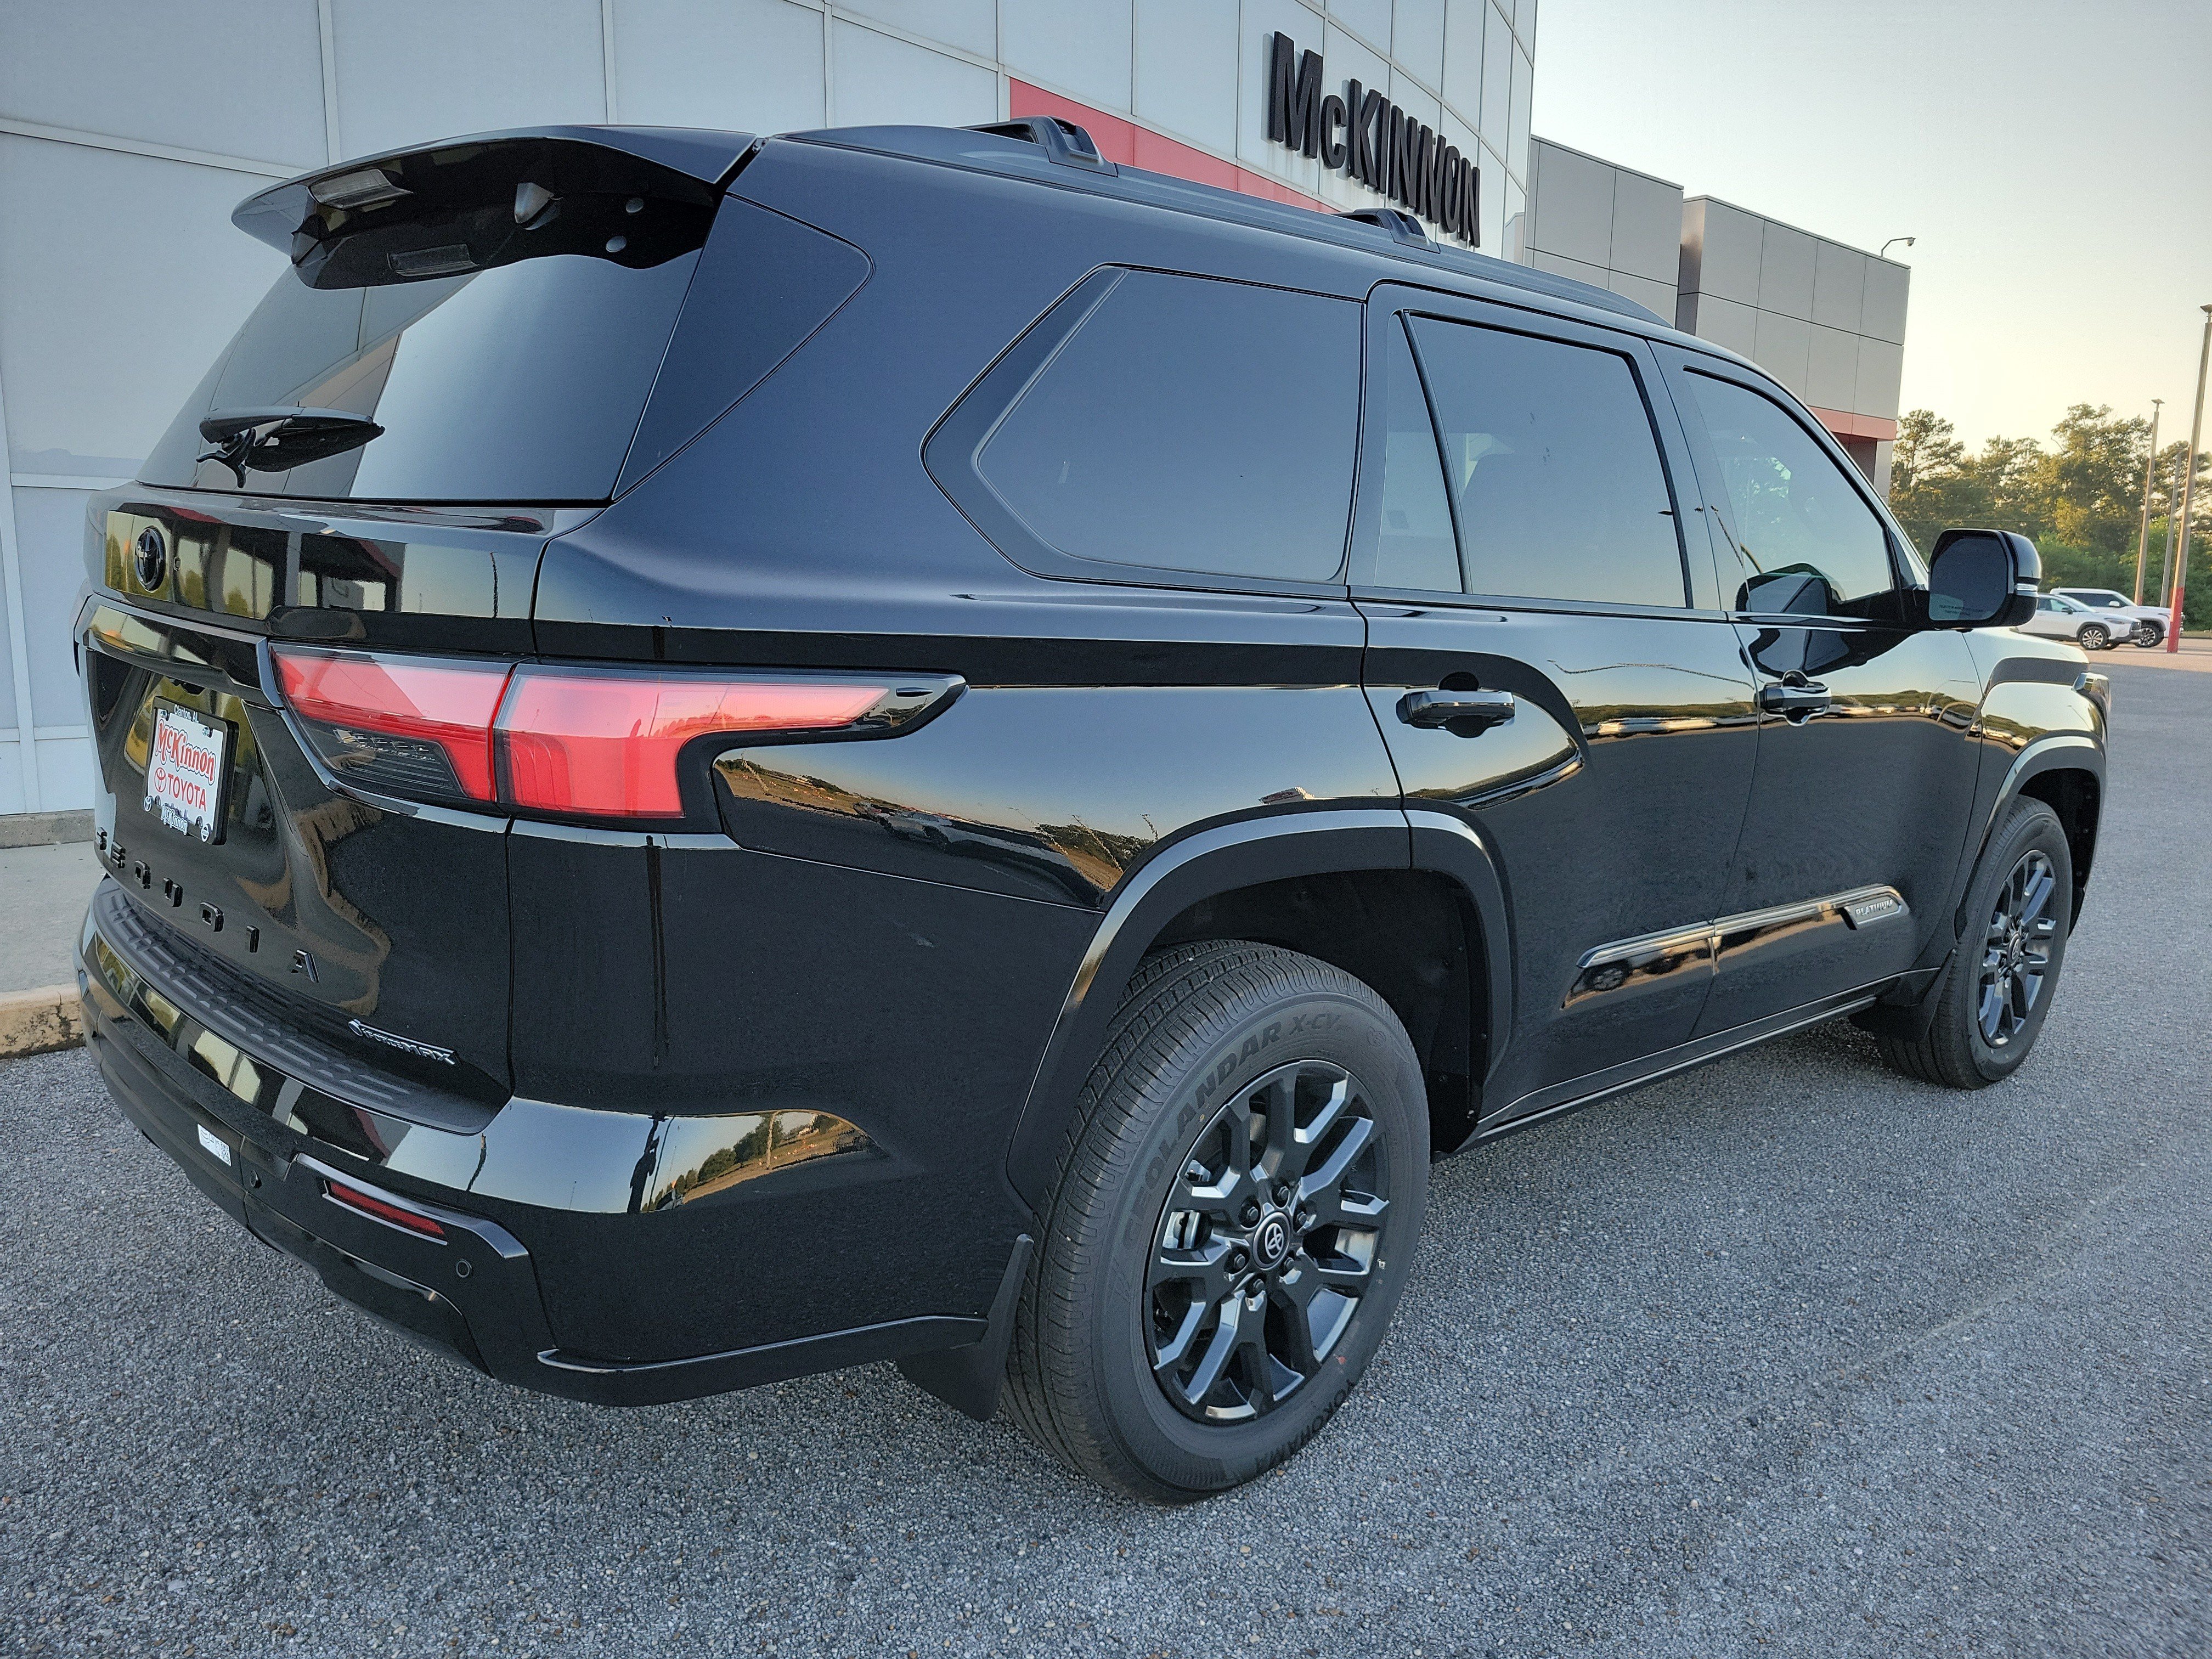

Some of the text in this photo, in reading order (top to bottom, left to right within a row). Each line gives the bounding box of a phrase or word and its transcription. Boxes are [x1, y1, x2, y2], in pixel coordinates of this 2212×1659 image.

[155, 719, 216, 785] McKinnon
[161, 804, 188, 836] McKinnon
[168, 773, 207, 812] TOYOTA
[95, 826, 319, 983] SEQUOIA
[1123, 1013, 1341, 1249] GEOLANDAR X-CV
